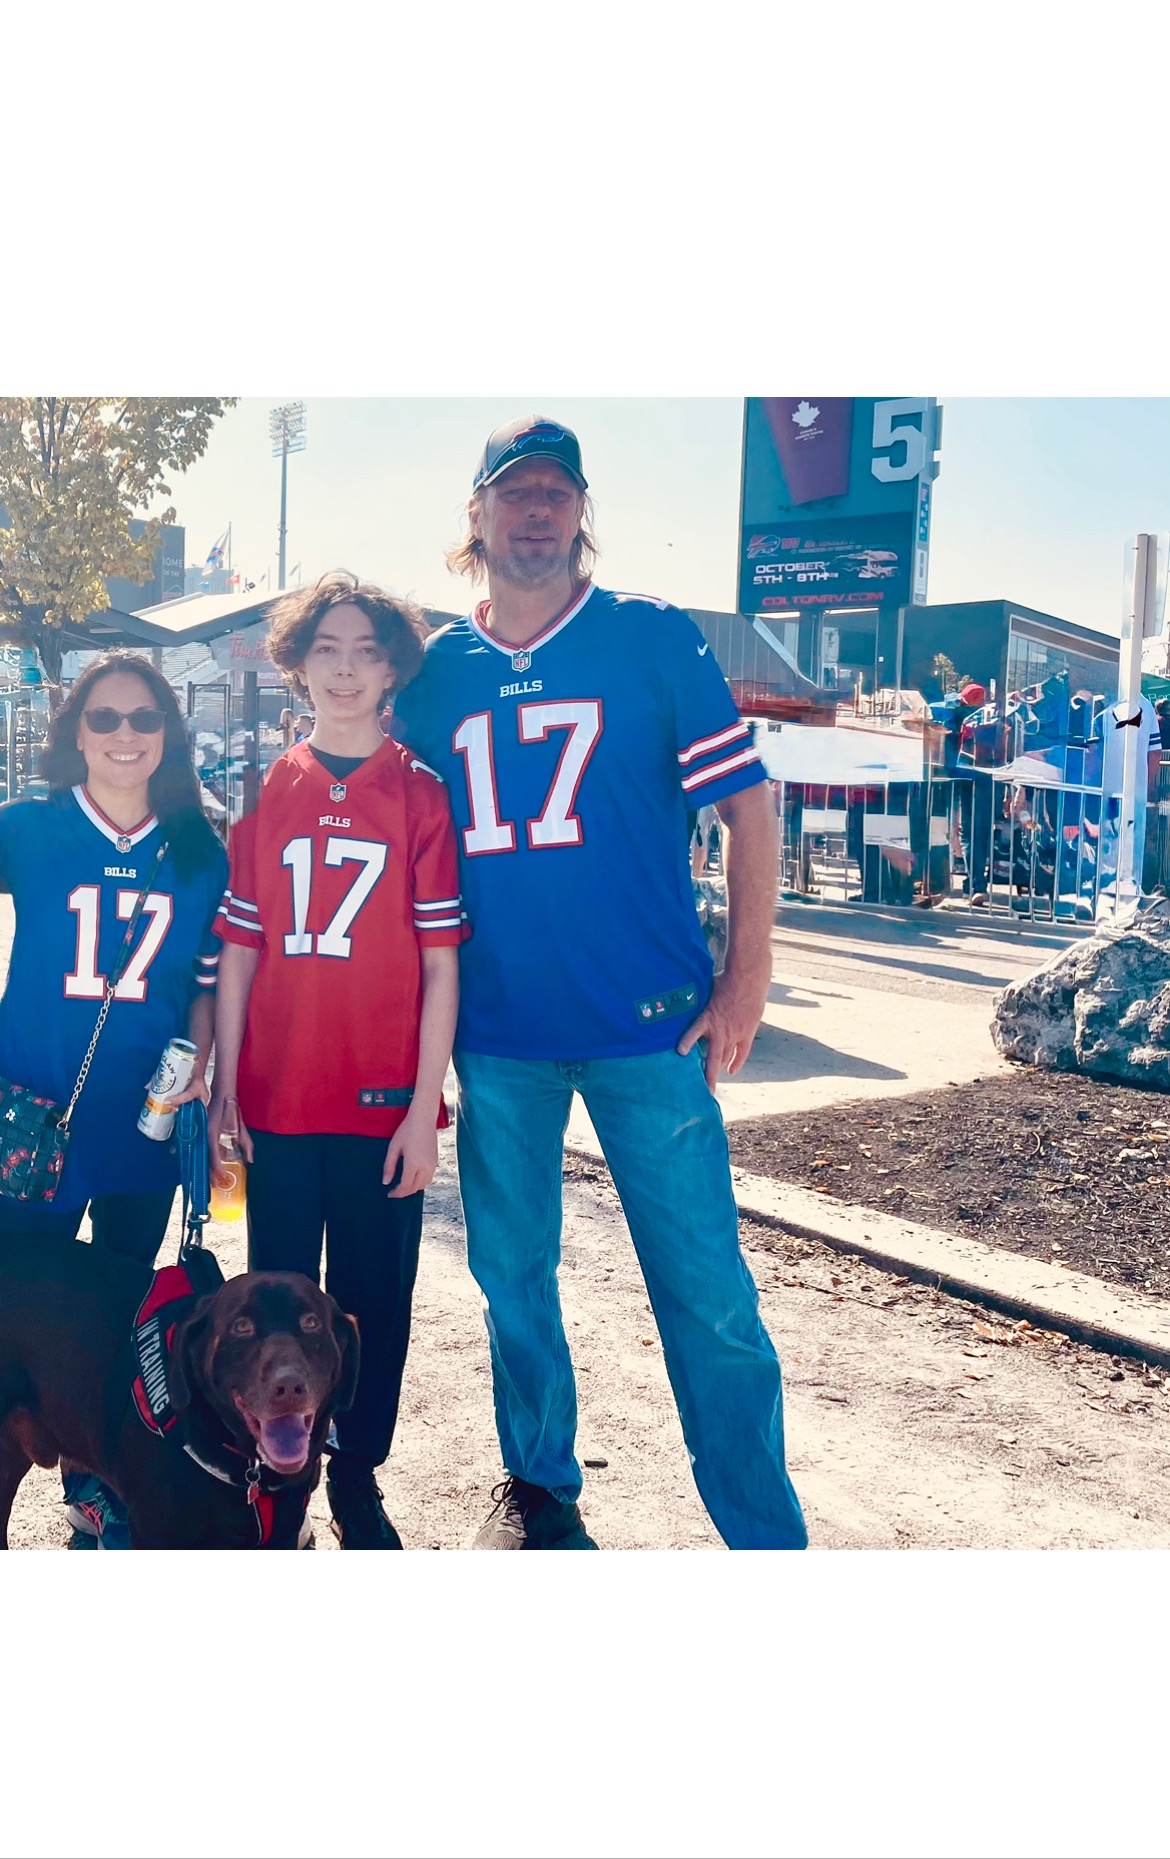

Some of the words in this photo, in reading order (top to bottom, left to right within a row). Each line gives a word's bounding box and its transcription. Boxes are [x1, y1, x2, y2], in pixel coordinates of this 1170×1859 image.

[871, 397, 927, 483] 5
[755, 561, 826, 574] OCTOBER
[753, 575, 783, 585] 5TH
[762, 592, 885, 606] COLTONRV.COM
[515, 658, 528, 668] NFL
[499, 679, 543, 698] BILLS
[452, 698, 604, 858] 17
[318, 815, 352, 828] BILLS
[104, 866, 137, 879] BILLS
[281, 835, 388, 959] 17
[64, 884, 174, 1003] 17
[137, 1317, 159, 1343] IN
[139, 1332, 170, 1415] TRAINING
